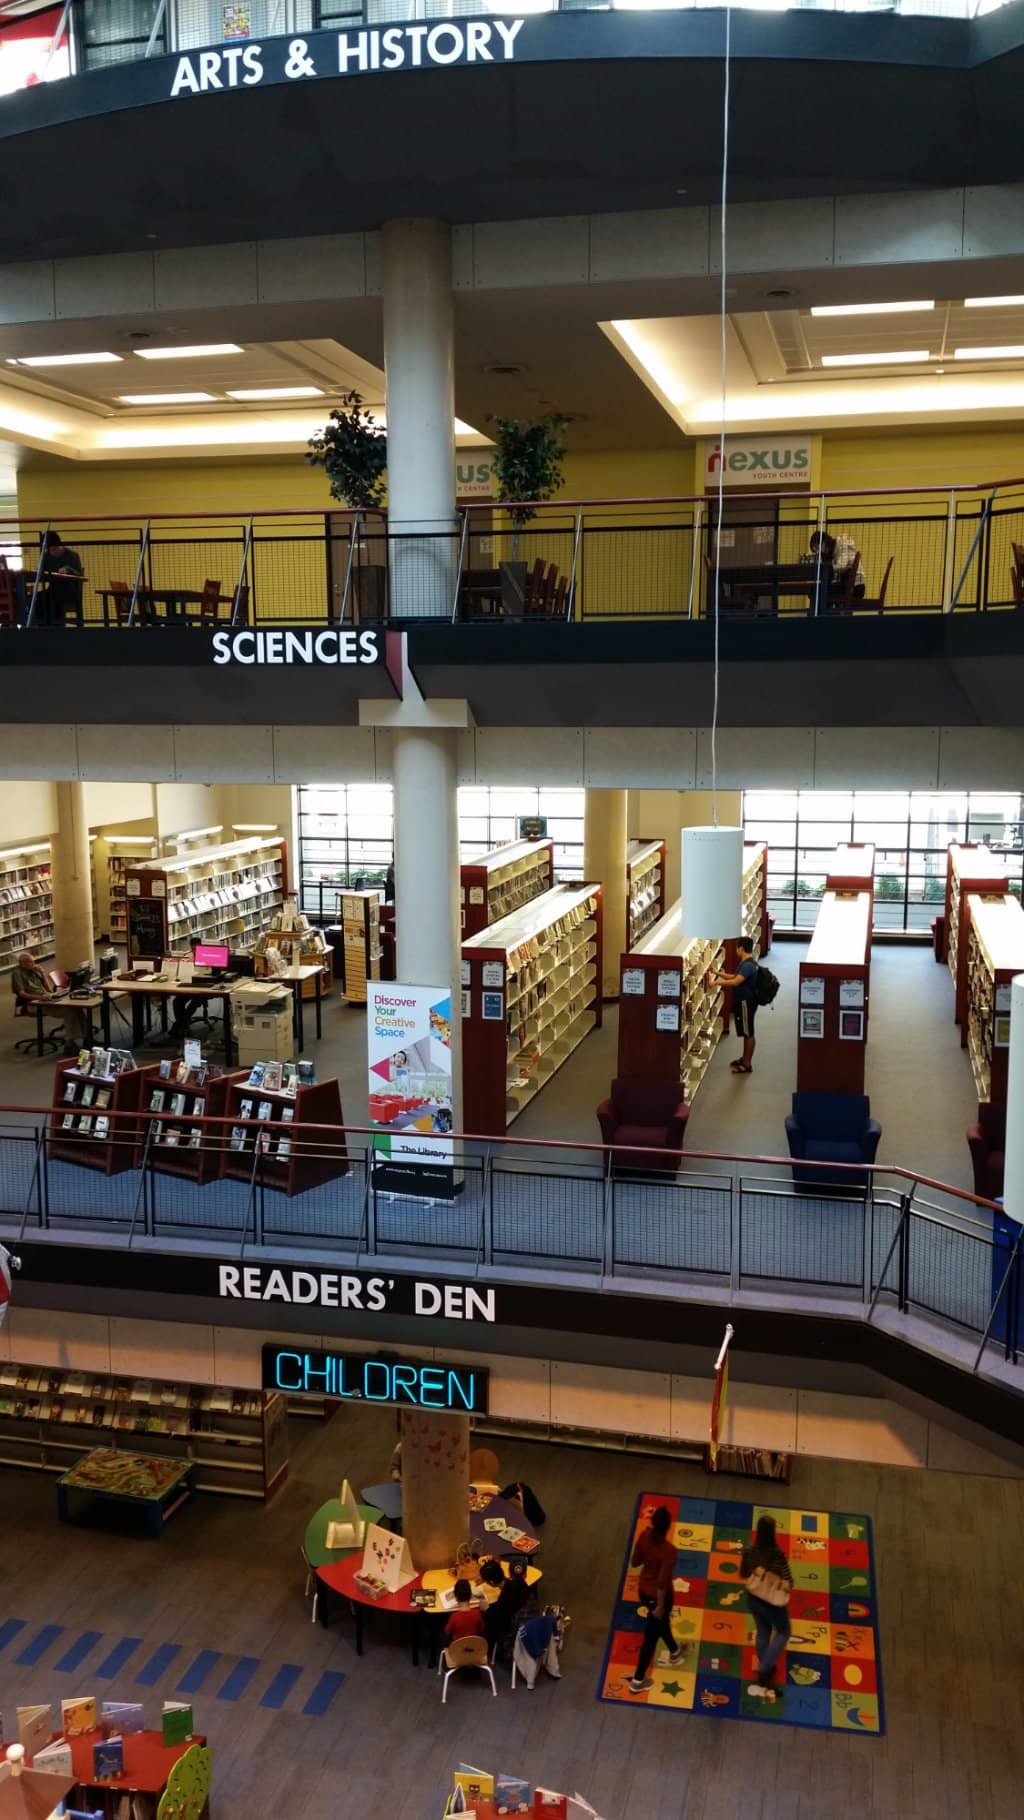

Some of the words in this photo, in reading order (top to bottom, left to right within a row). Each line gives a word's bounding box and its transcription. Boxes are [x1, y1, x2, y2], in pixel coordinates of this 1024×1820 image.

[170, 46, 263, 97] ARTS
[285, 39, 316, 79] &
[338, 19, 525, 73] HISTORY
[707, 444, 809, 473] nexus
[753, 472, 777, 480] YOUTH
[779, 471, 808, 479] CENTRE
[213, 631, 378, 664] SCIENCES
[374, 995, 416, 1007] Discover
[375, 1006, 396, 1016] Your
[375, 1016, 415, 1028] Creative
[375, 1027, 405, 1038] Space
[219, 1265, 394, 1311] READERS'
[415, 1282, 496, 1322] DEN
[277, 1353, 475, 1410] CHILDREN
